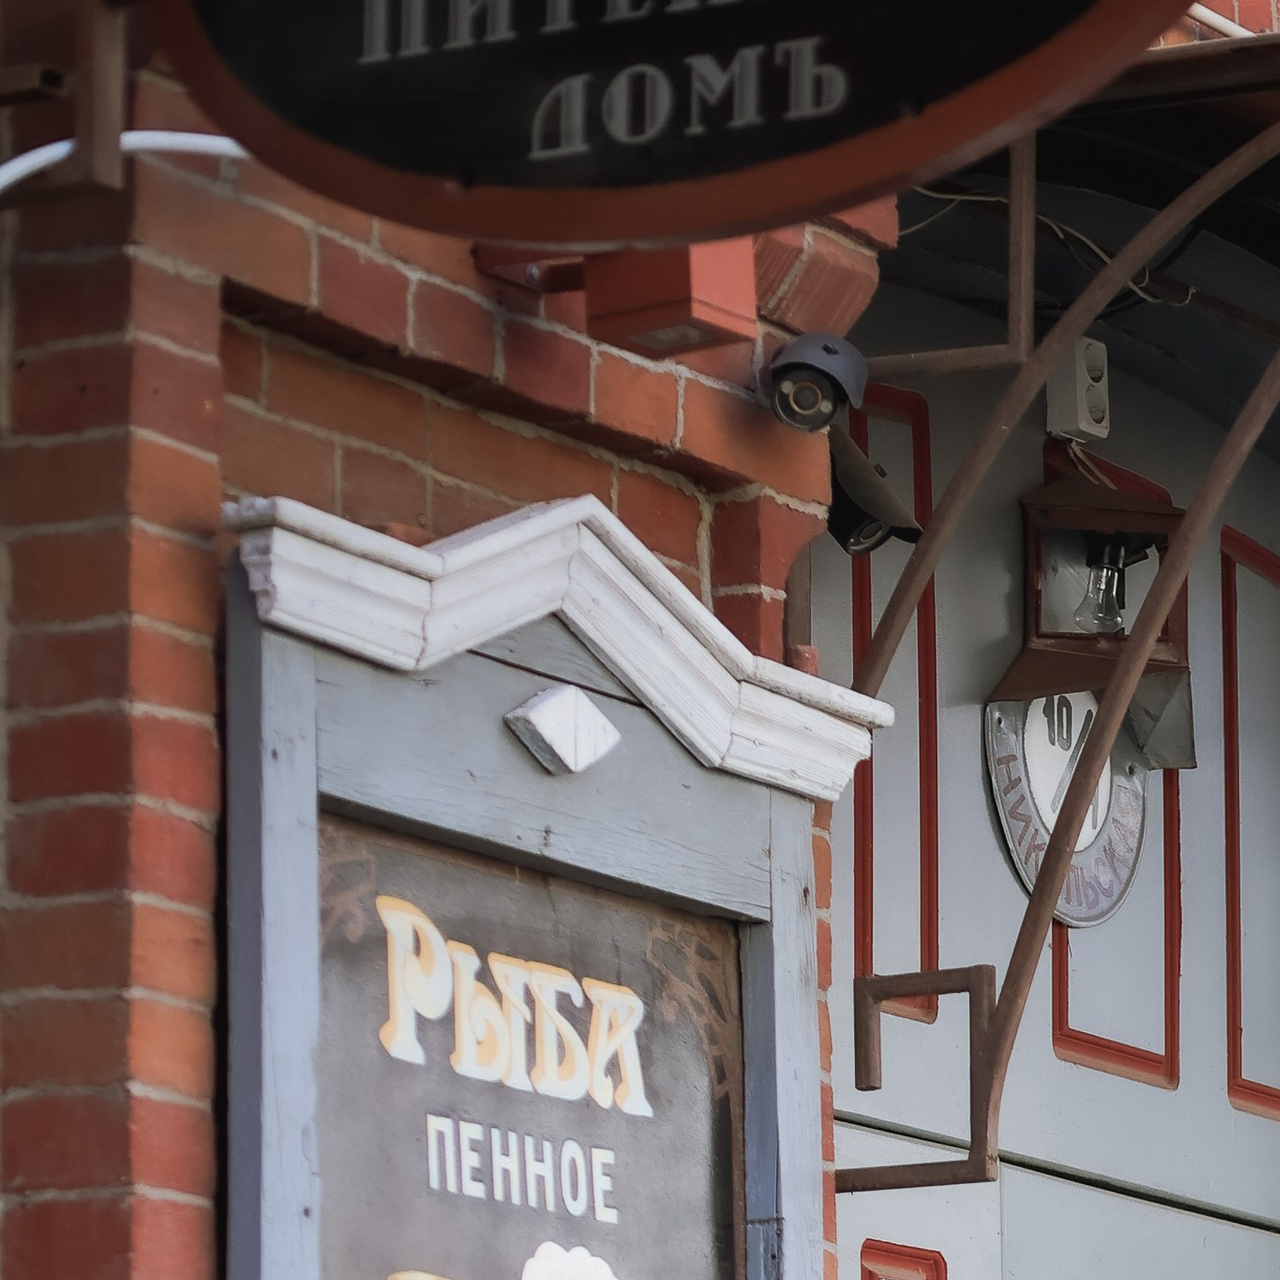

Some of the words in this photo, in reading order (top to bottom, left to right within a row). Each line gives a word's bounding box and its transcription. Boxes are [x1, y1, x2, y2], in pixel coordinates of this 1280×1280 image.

[527, 36, 848, 160] ДОМЪ
[375, 894, 654, 1118] РЫБА
[426, 1113, 619, 1224] ПЕННОЕ
